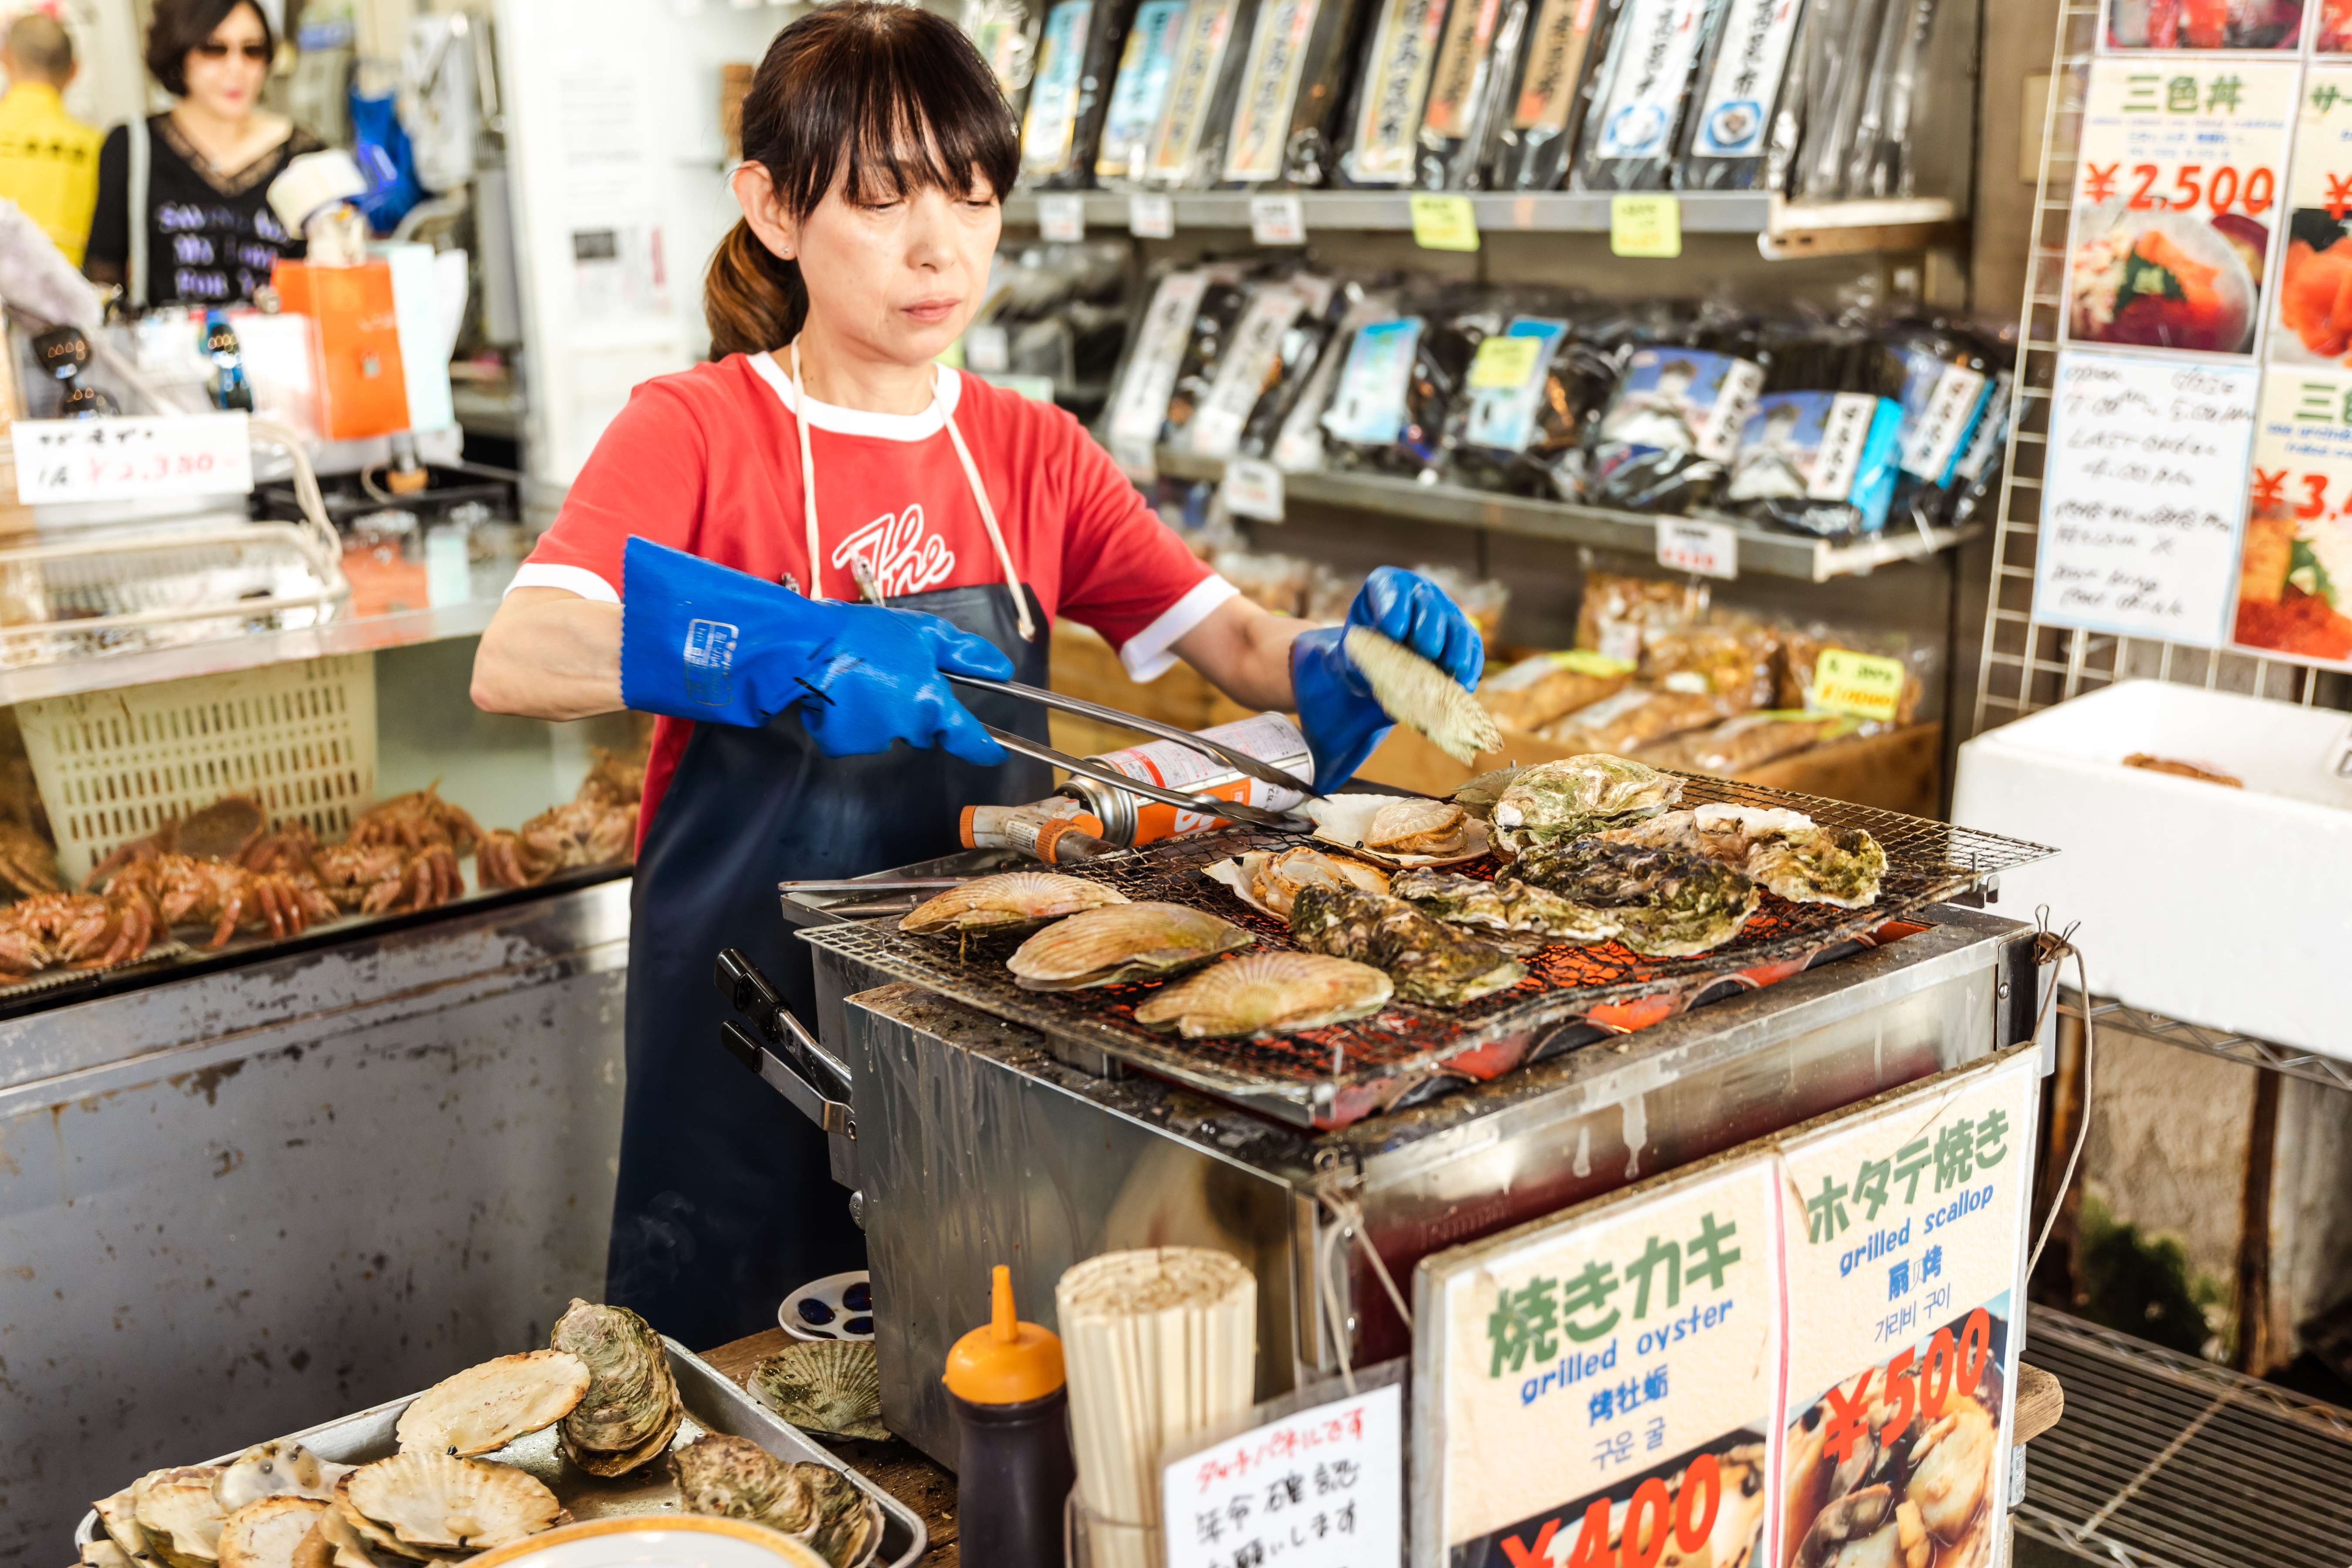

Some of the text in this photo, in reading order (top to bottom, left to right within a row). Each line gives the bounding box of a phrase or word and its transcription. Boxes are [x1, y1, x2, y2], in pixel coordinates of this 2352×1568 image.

[2084, 162, 2275, 215] ¥2,500
[831, 503, 956, 598] The
[1808, 1108, 2008, 1244] ホタテ焼き
[1840, 1184, 1994, 1277] grilled scallop
[1487, 1211, 1741, 1379] 焼きカキ
[1875, 1283, 1950, 1343] 가리비 구이
[1521, 1299, 1734, 1406] grilled oyster
[1823, 1307, 1990, 1465] ¥500
[1590, 1417, 1666, 1470] 구운 굴
